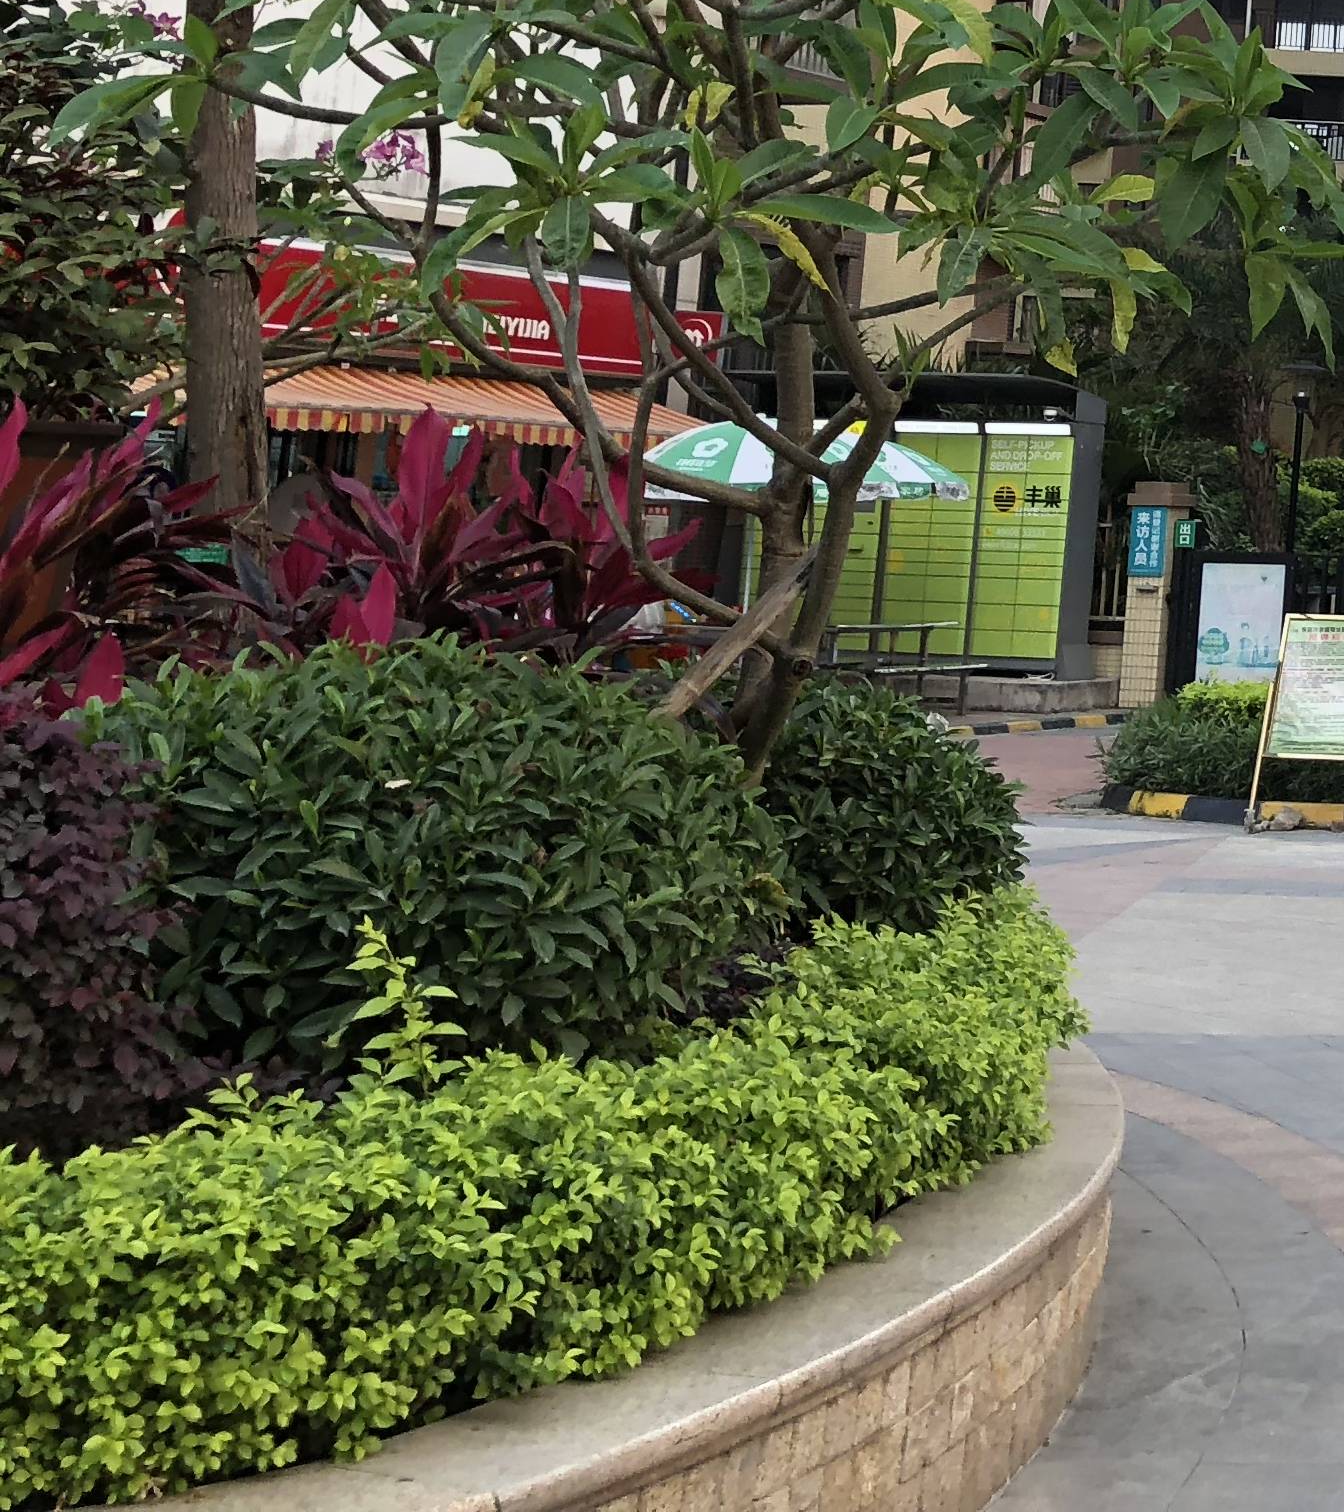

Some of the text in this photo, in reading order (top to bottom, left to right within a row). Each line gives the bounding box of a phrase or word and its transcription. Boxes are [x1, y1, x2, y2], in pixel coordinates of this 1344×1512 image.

[1024, 485, 1062, 508] 丰巢
[1134, 511, 1150, 567] 来访人员
[1179, 523, 1191, 545] 出口
